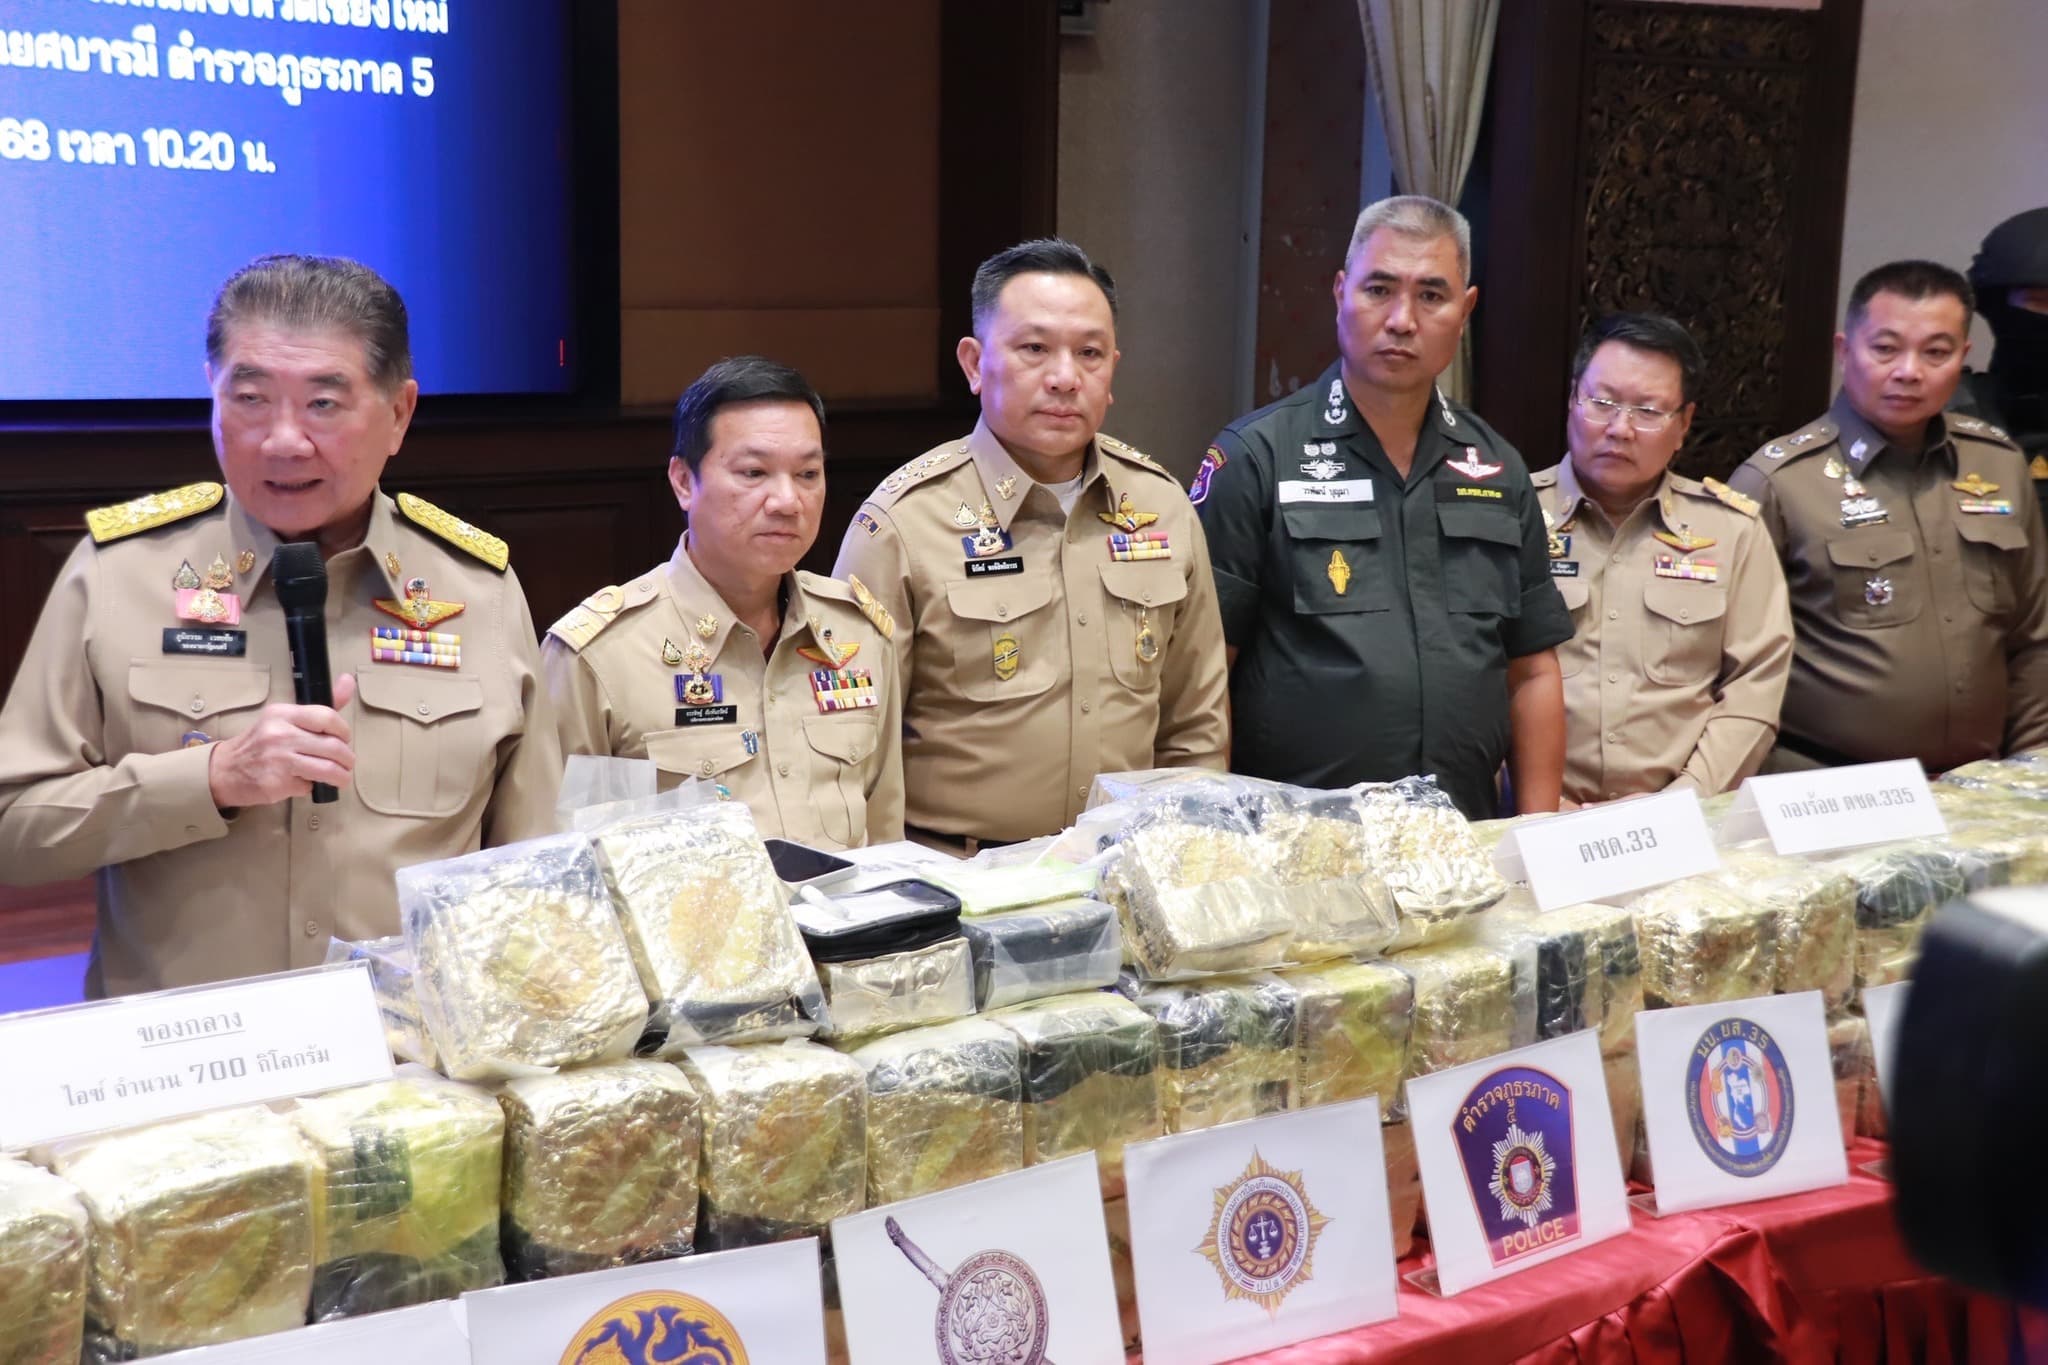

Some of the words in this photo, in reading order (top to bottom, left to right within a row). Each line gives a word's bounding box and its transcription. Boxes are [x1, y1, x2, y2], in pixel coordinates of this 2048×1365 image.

[0, 24, 159, 77] ยศบารมี
[168, 29, 403, 106] ตำรวจภูธรภาค
[412, 56, 434, 97] 5
[58, 130, 136, 165] เวลา
[142, 128, 235, 171] 10.20
[242, 140, 276, 173] น.
[1779, 792, 1839, 820] กองร้อย
[1846, 786, 1916, 813] ตชด.335
[1578, 827, 1658, 864] ตชด.33
[137, 1011, 243, 1043] ของกลาง
[62, 1079, 105, 1106] ไอซ์
[115, 1072, 182, 1098] จำนวน
[189, 1057, 247, 1084] 700
[256, 1045, 330, 1073] กิโลกรัม
[1462, 1080, 1561, 1133] ตำรวจภูธรภาค
[1501, 1217, 1566, 1256] POLICE
